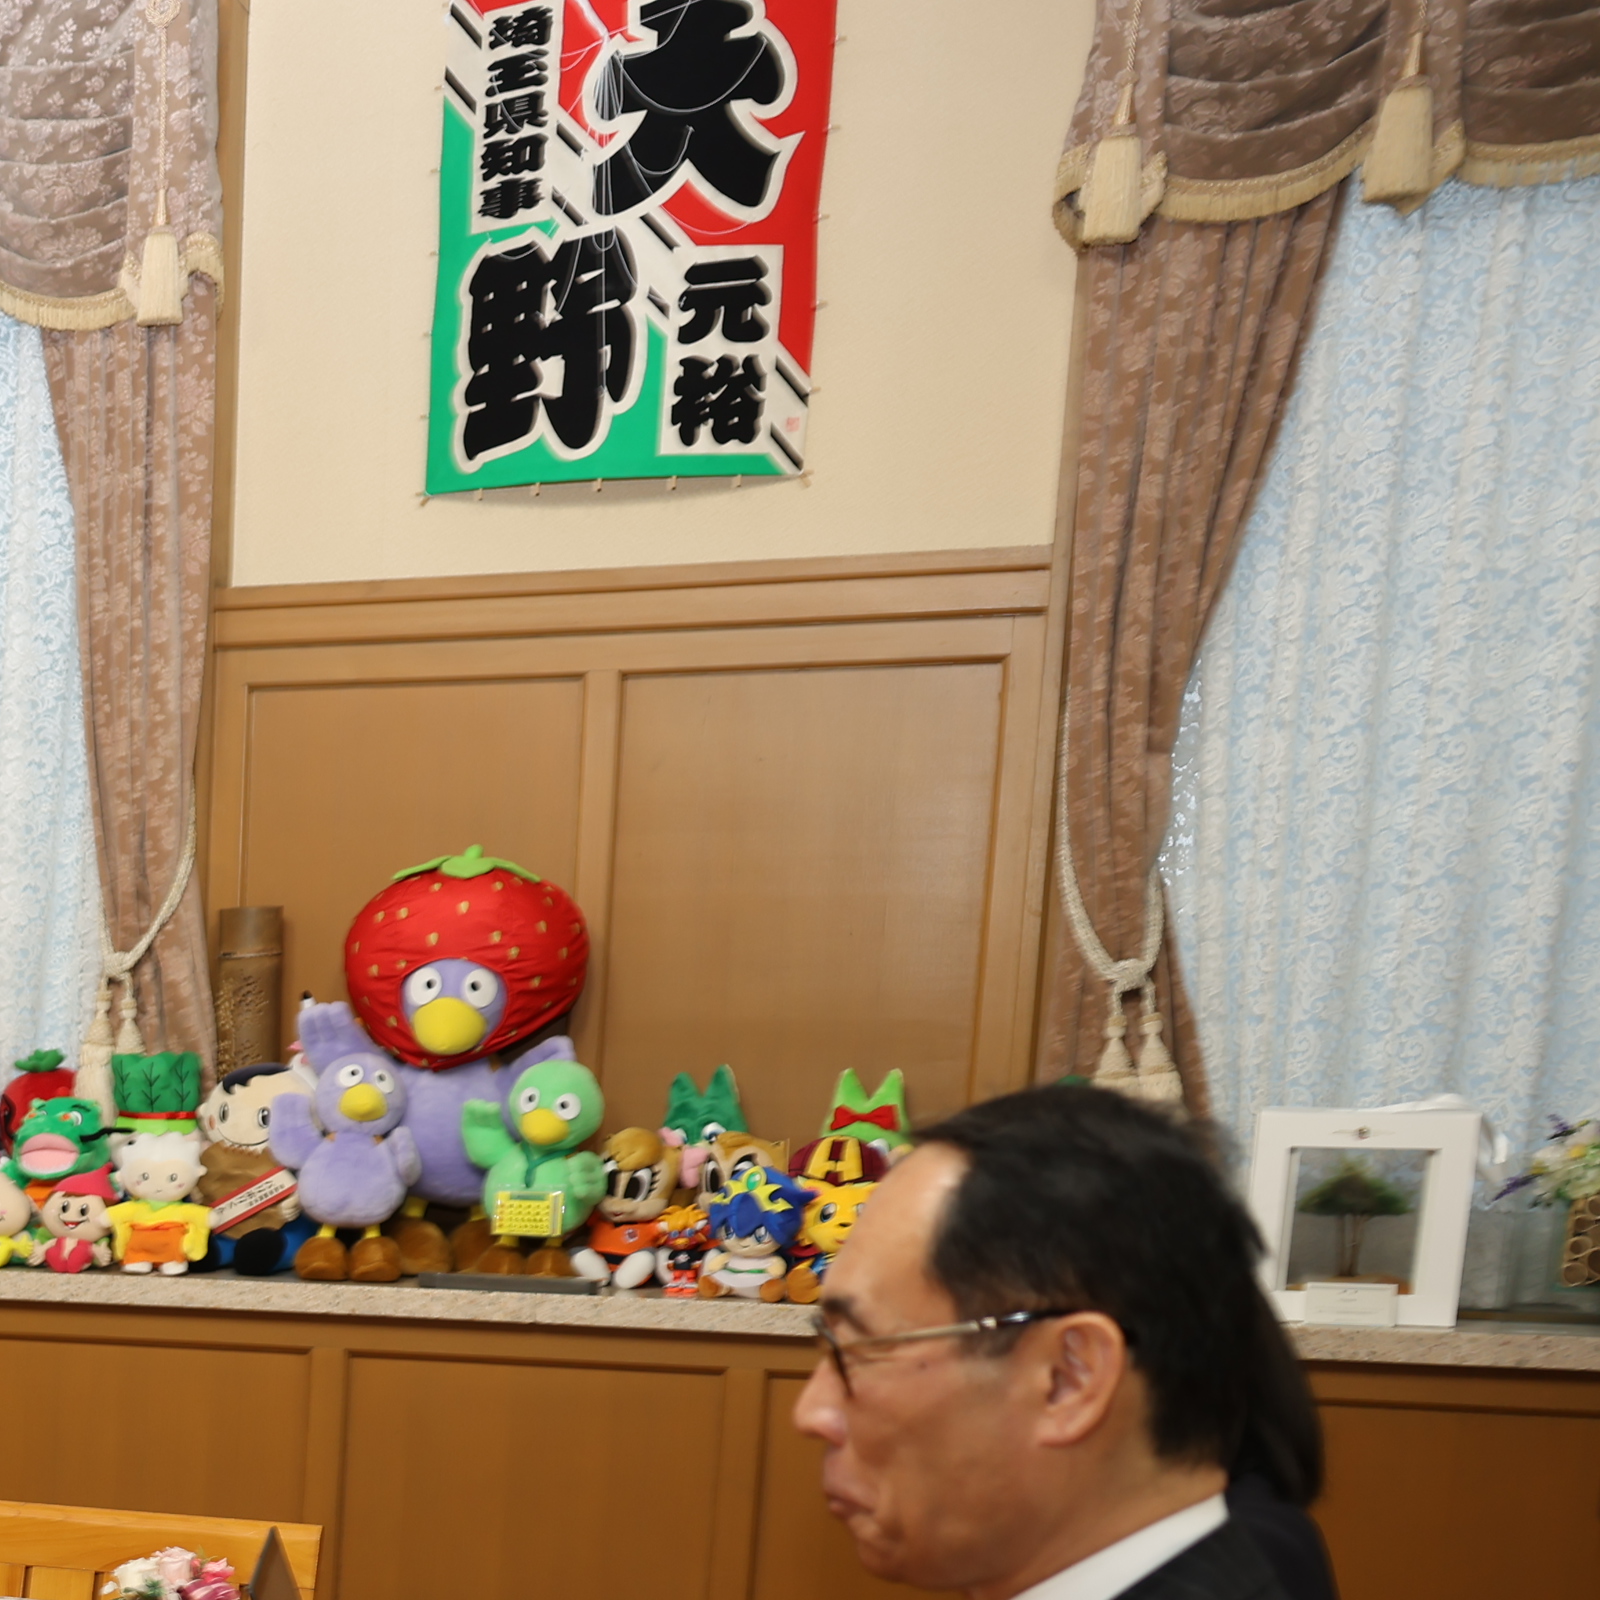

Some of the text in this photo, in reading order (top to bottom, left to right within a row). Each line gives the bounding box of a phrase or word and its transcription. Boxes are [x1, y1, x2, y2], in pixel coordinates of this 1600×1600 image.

[477, 4, 554, 220] 埼玉県知事
[670, 254, 774, 447] 元裕
